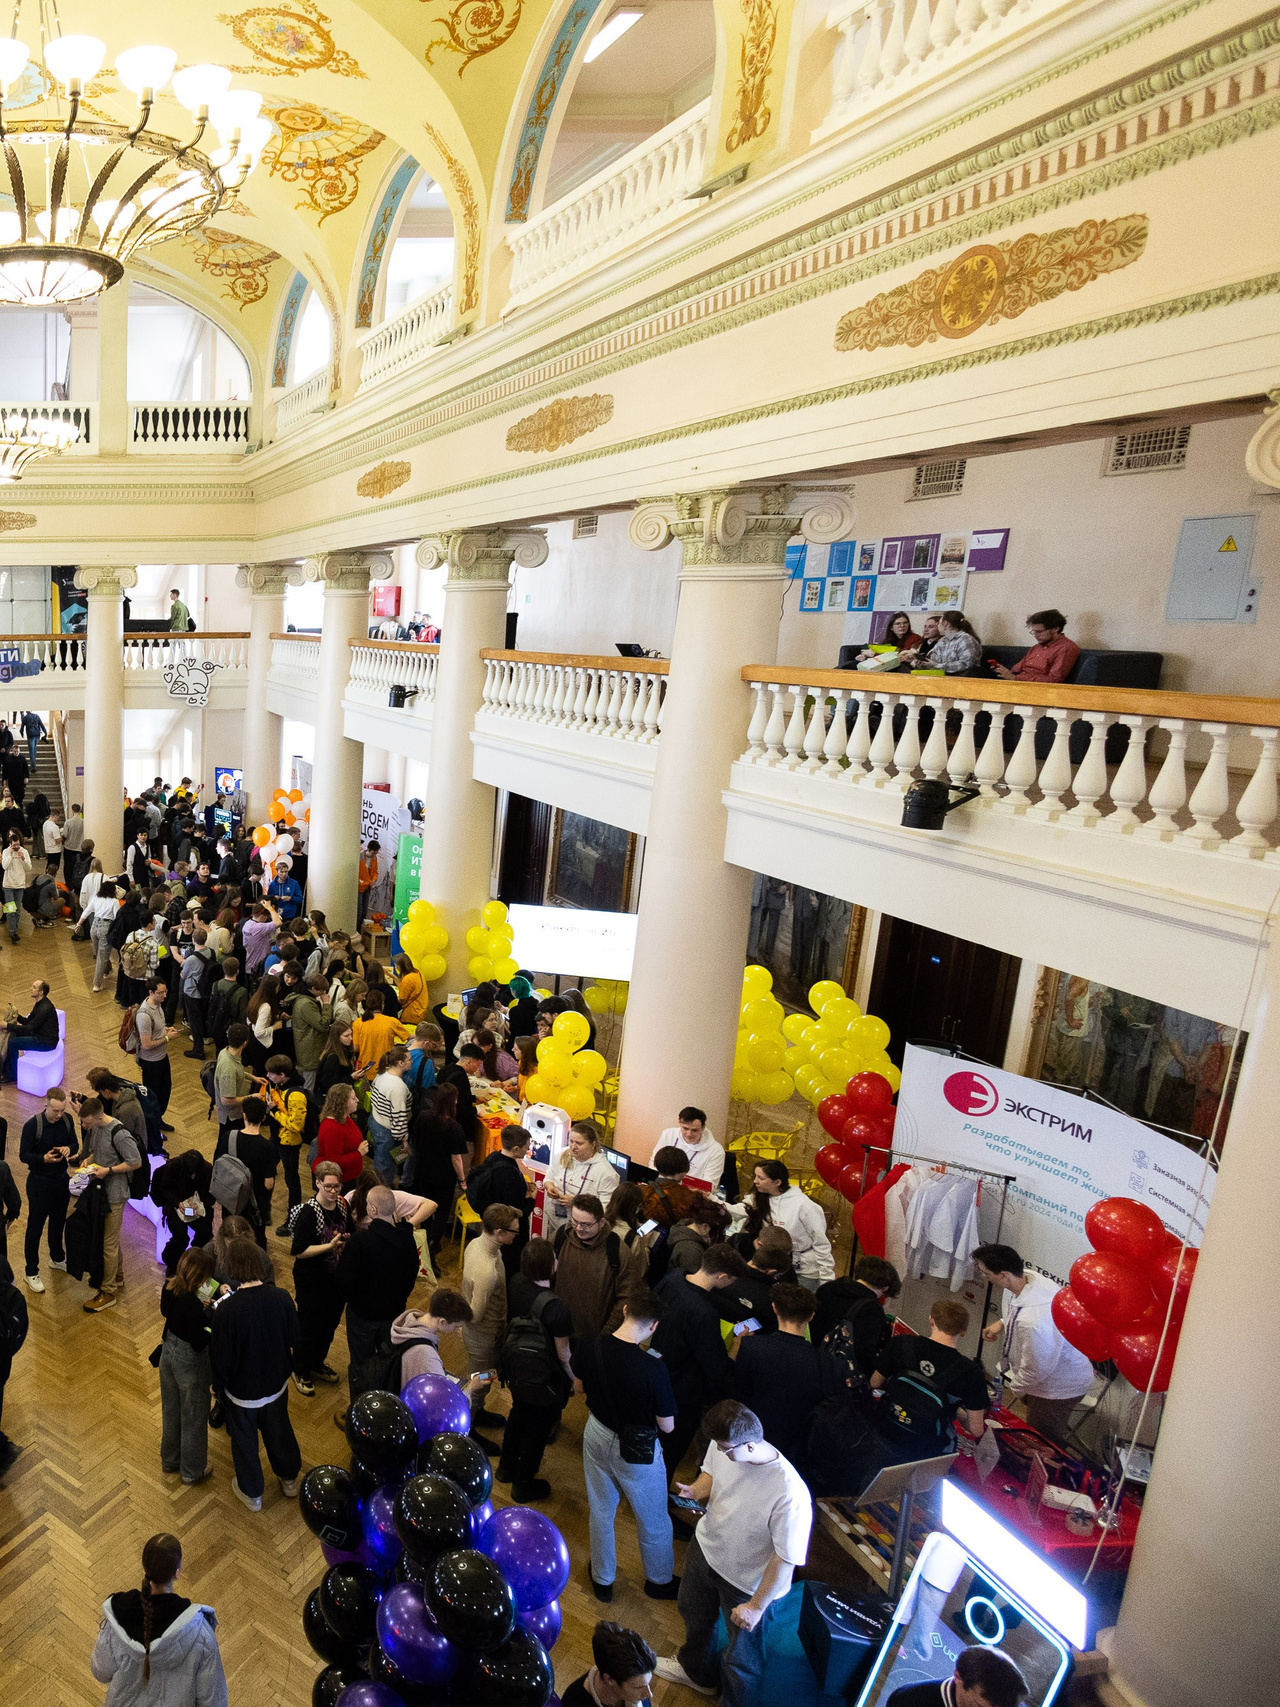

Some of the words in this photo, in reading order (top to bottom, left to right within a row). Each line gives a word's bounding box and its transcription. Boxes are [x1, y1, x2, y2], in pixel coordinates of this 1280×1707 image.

[362, 810, 389, 831] РОЕМ
[1003, 1098, 1093, 1143] ЭКСТРИМ
[962, 1123, 1068, 1168] Разрабатываем
[1072, 1166, 1093, 1181] то,
[985, 1141, 1012, 1156] что
[1014, 1153, 1078, 1185] улучшает
[1080, 1182, 1112, 1200] жизн
[1153, 1163, 1186, 1187] Заказная
[1028, 1201, 1052, 1217] 2024
[1148, 1187, 1186, 1216] Системная
[1036, 1265, 1071, 1287] техно
